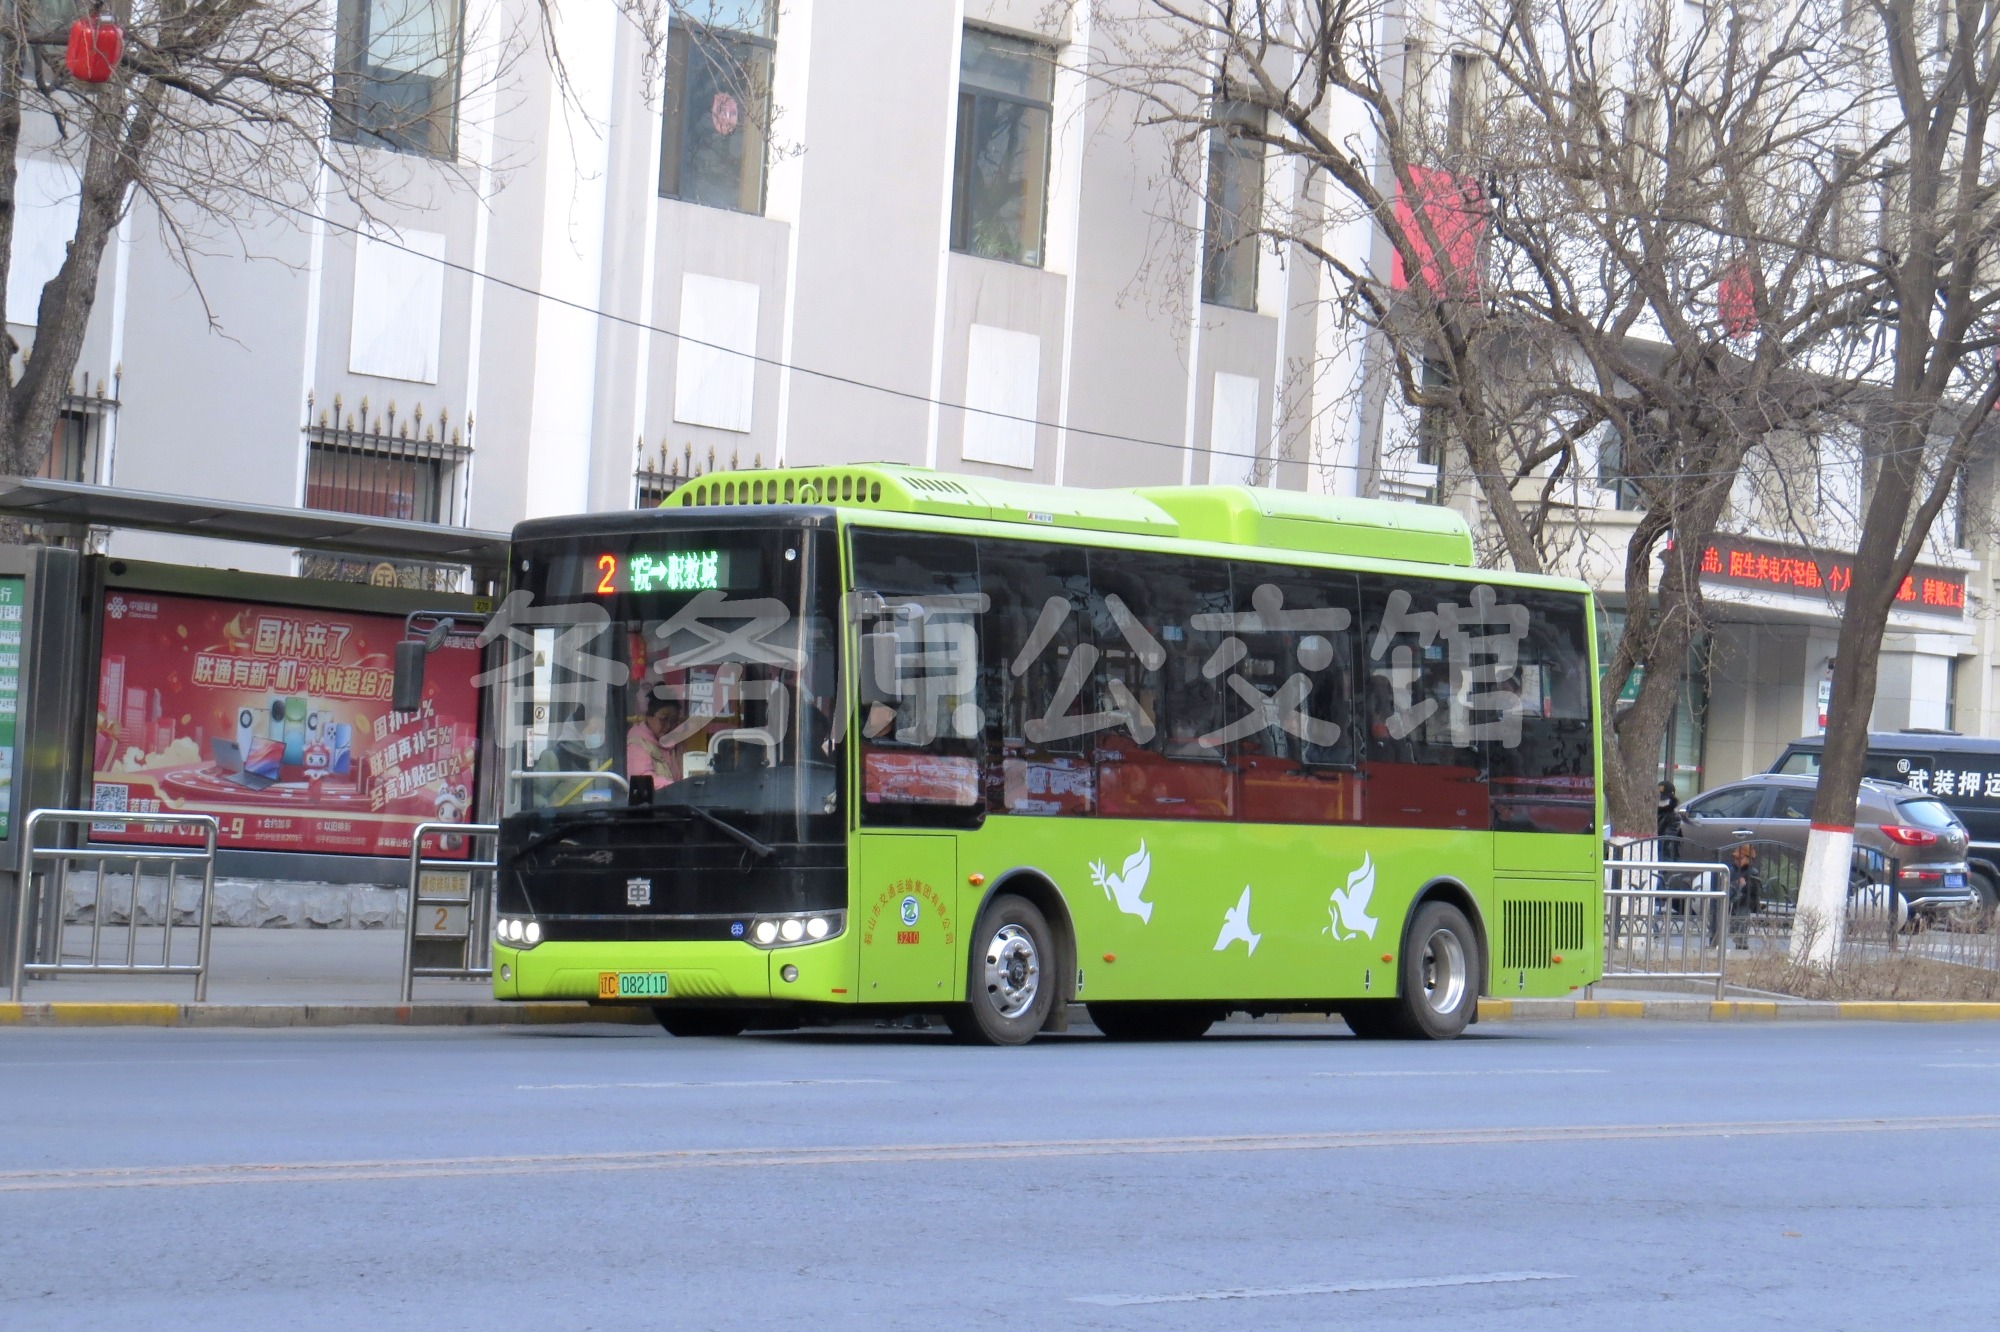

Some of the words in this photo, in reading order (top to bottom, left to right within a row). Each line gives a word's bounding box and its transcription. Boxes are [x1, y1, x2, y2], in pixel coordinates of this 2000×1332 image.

[598, 555, 616, 593] 2
[255, 619, 350, 660] 国补来了
[435, 908, 448, 931] 2
